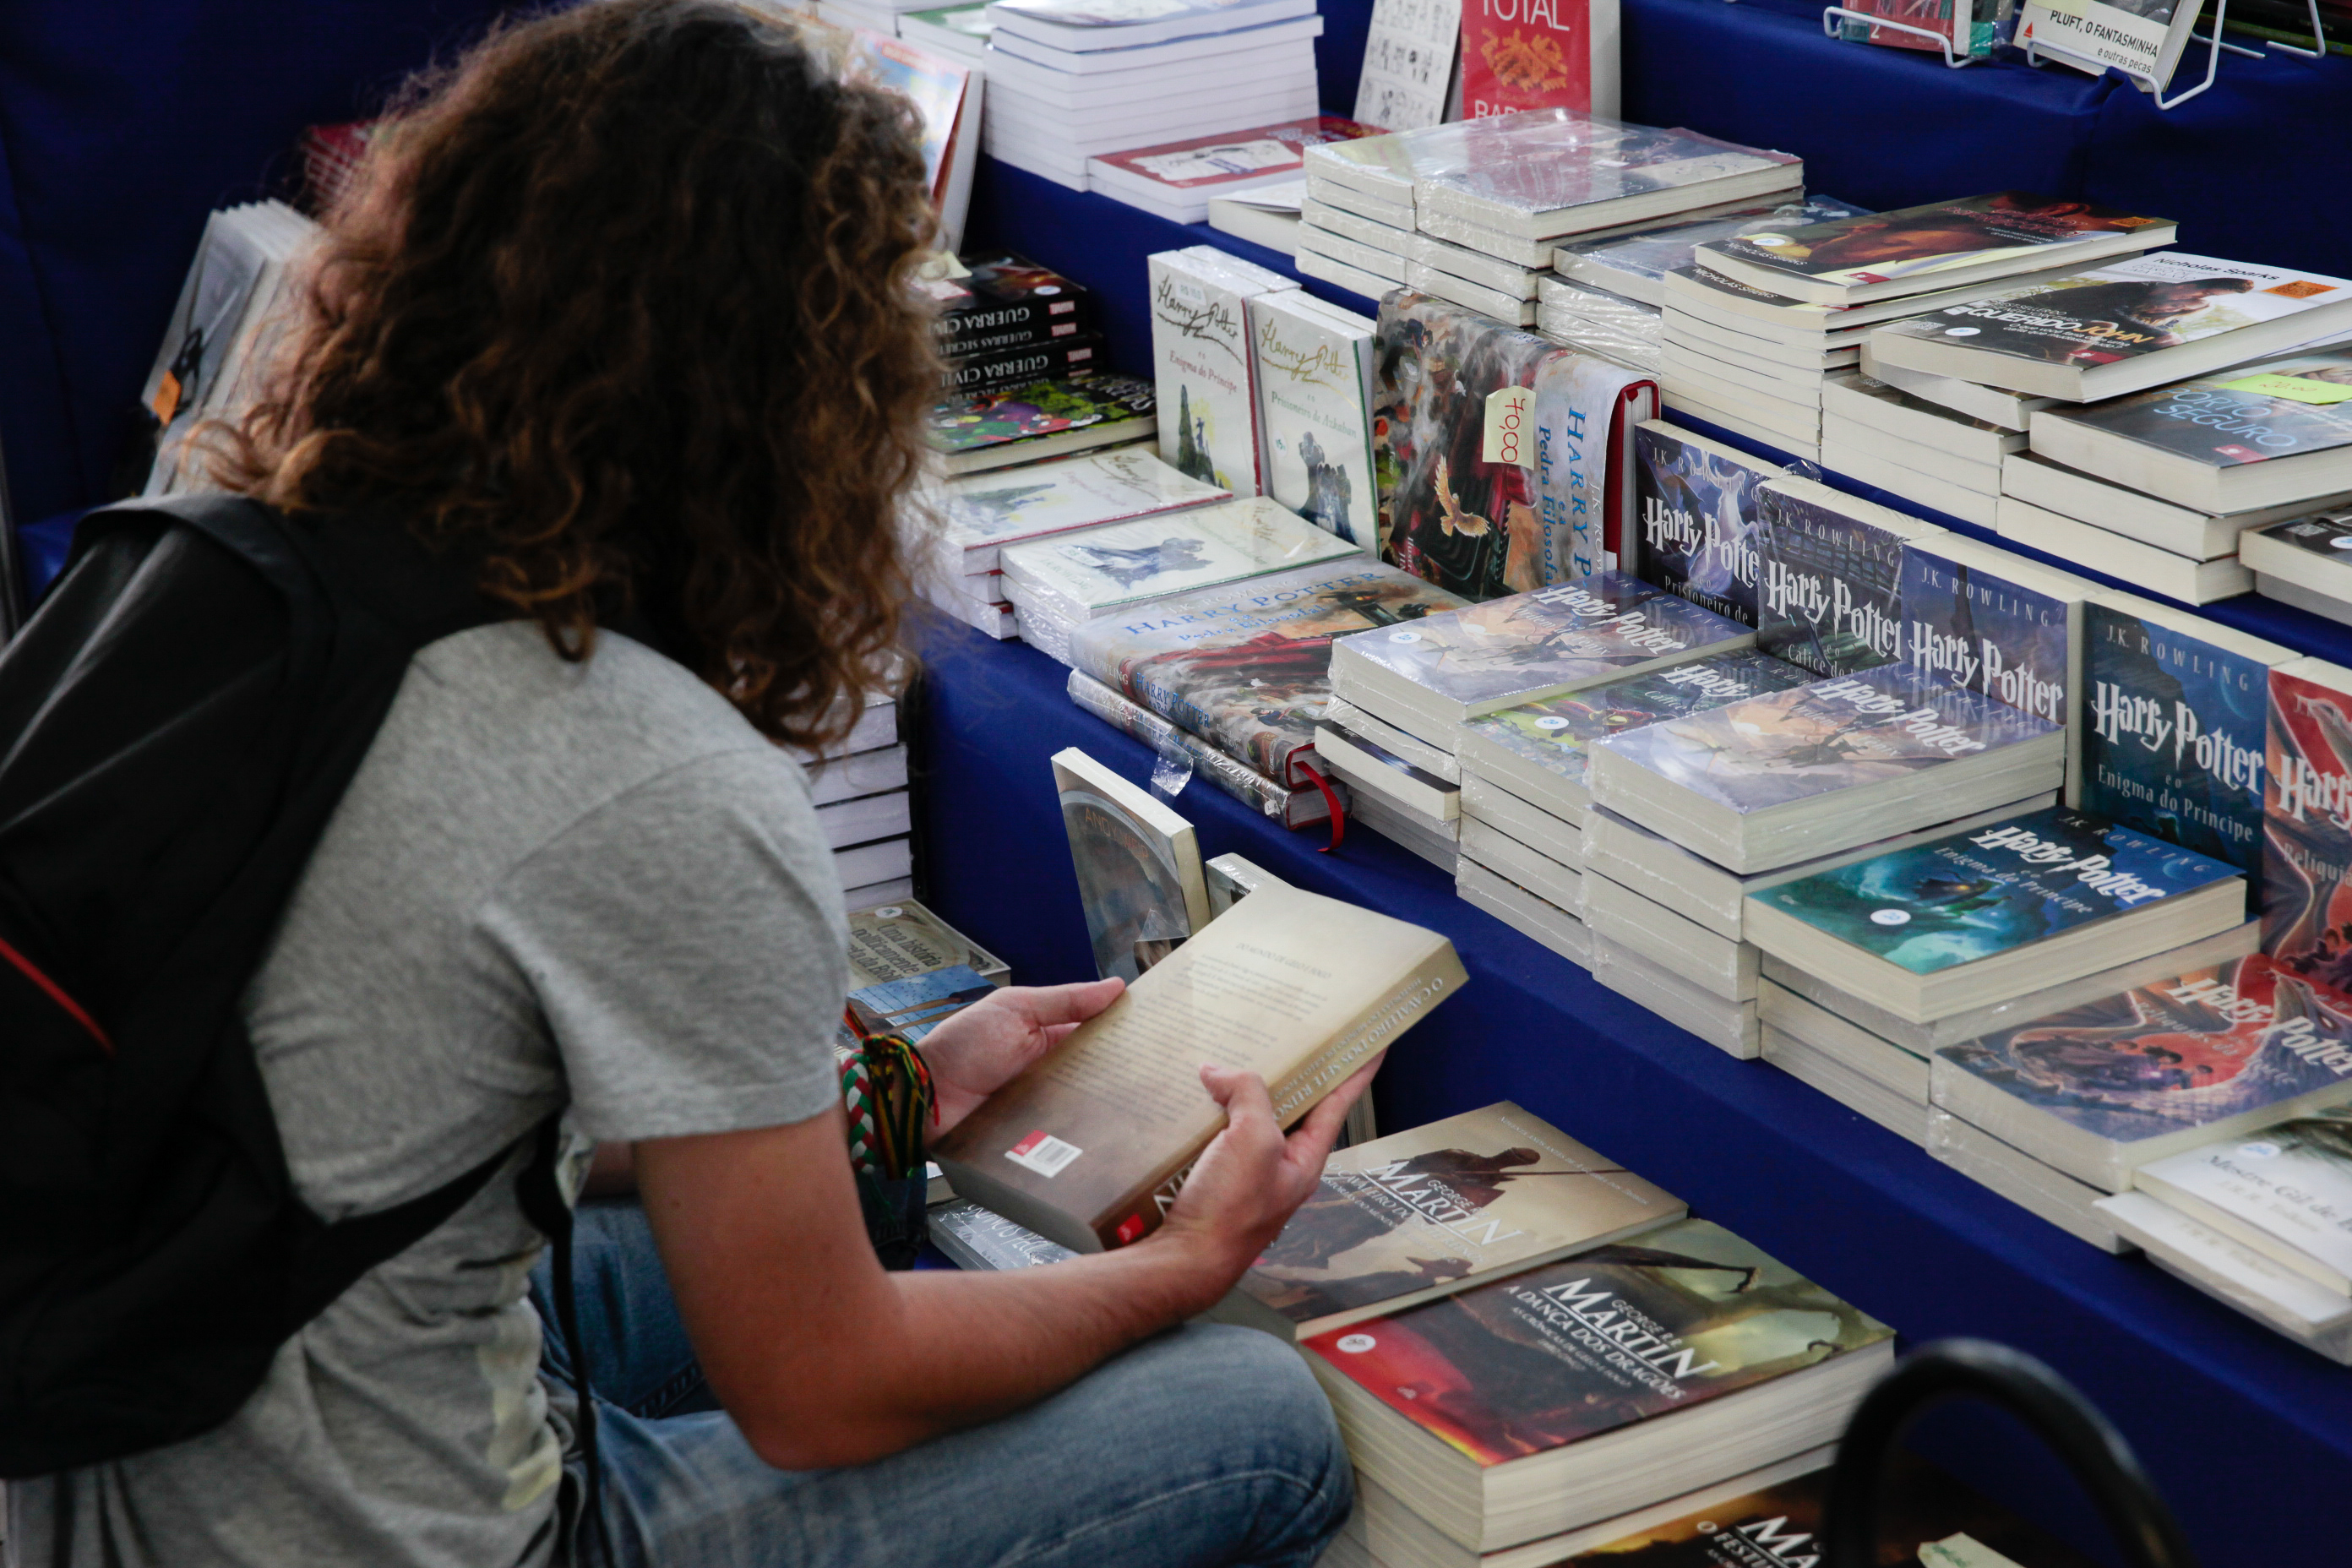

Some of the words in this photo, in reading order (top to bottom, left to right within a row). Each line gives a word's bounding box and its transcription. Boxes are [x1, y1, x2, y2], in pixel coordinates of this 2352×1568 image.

[2050, 10, 2083, 34] PLUFT,
[2086, 22, 2093, 34] O
[2093, 24, 2159, 57] FANTASMINHA
[2104, 51, 2127, 66] outras
[2153, 259, 2221, 272] Nicholas
[2224, 269, 2279, 280] Sparks
[964, 307, 1030, 329] GUERRA
[1968, 308, 2082, 329] QUERIDO
[2073, 325, 2155, 345] JOHN
[984, 355, 1048, 378] GUERRA
[1271, 390, 1311, 419] Prisioneiro
[1313, 411, 1320, 422] de
[1322, 415, 1357, 438] Azkaban
[2152, 387, 2272, 417] PORTO
[2153, 404, 2298, 447] SEGURO
[1539, 424, 1553, 486] Pedra
[1568, 406, 1588, 543] HARRY
[1652, 447, 1669, 466] J.K.
[1678, 458, 1757, 502] ROWLING
[1542, 494, 1559, 587] Filosofa
[1642, 496, 1702, 558] Harry
[1704, 511, 1760, 589] Potte
[1777, 509, 1795, 531] J.K.
[1805, 519, 1895, 568] ROWLING
[1124, 603, 1246, 634] HARRY
[1250, 572, 1386, 607] POTTER
[1202, 579, 1299, 607] ROWLING
[1664, 575, 1730, 618] Prisioneiro
[1734, 605, 1748, 625] de
[1764, 559, 1831, 624] Harry
[1921, 567, 1941, 589] J.K.
[1952, 577, 2048, 627] ROWLING
[1178, 626, 1237, 642] Pedra
[1238, 605, 1326, 630] Filosofal
[1532, 585, 1619, 617] Harry
[1588, 610, 1687, 655] Potter
[1658, 664, 1750, 697] Harry
[1908, 620, 1979, 688] Harry
[1982, 638, 2064, 723] Potter
[2106, 625, 2130, 649] J.K.
[2141, 635, 2249, 691] ROWLING
[1135, 672, 1171, 706] HARRY
[1172, 692, 1211, 728] POTTER
[1810, 679, 1906, 715] Harry
[1876, 707, 1986, 756] Potter
[2090, 680, 2173, 752] Harry
[2175, 700, 2264, 796] Potter
[2098, 763, 2153, 803] Enigma
[2159, 788, 2178, 812] do
[2165, 774, 2171, 785] e
[2175, 778, 2182, 789] o
[1086, 807, 1119, 839] ANDY
[1933, 847, 1997, 875] Enigma
[1995, 871, 2020, 883] do
[1968, 825, 2075, 863] Harry
[2044, 853, 2167, 905] Potter
[2093, 828, 2212, 873] ROWLING
[851, 928, 920, 972] politicamente
[877, 923, 903, 942] Uma
[898, 939, 942, 967] história
[1431, 977, 1444, 992] O
[2163, 977, 2278, 1023] Harry
[1367, 988, 1432, 1043] CAVALEIRO
[1313, 1062, 1342, 1087] SETE
[1342, 1040, 1369, 1064] DOS
[1273, 1083, 1314, 1120] REINO
[1326, 1162, 1341, 1171] O
[1335, 1164, 1399, 1211] CAVALEIRO
[1360, 1160, 1525, 1247] MARTIN
[1426, 1179, 1475, 1210] GEORGE
[1503, 1285, 1521, 1295] A
[1516, 1290, 1575, 1331] DANÇA
[1571, 1326, 1612, 1353] DOS
[1542, 1277, 1722, 1380] MARTIN
[1611, 1298, 1664, 1335] GEORGE
[1696, 1521, 1718, 1534] O
